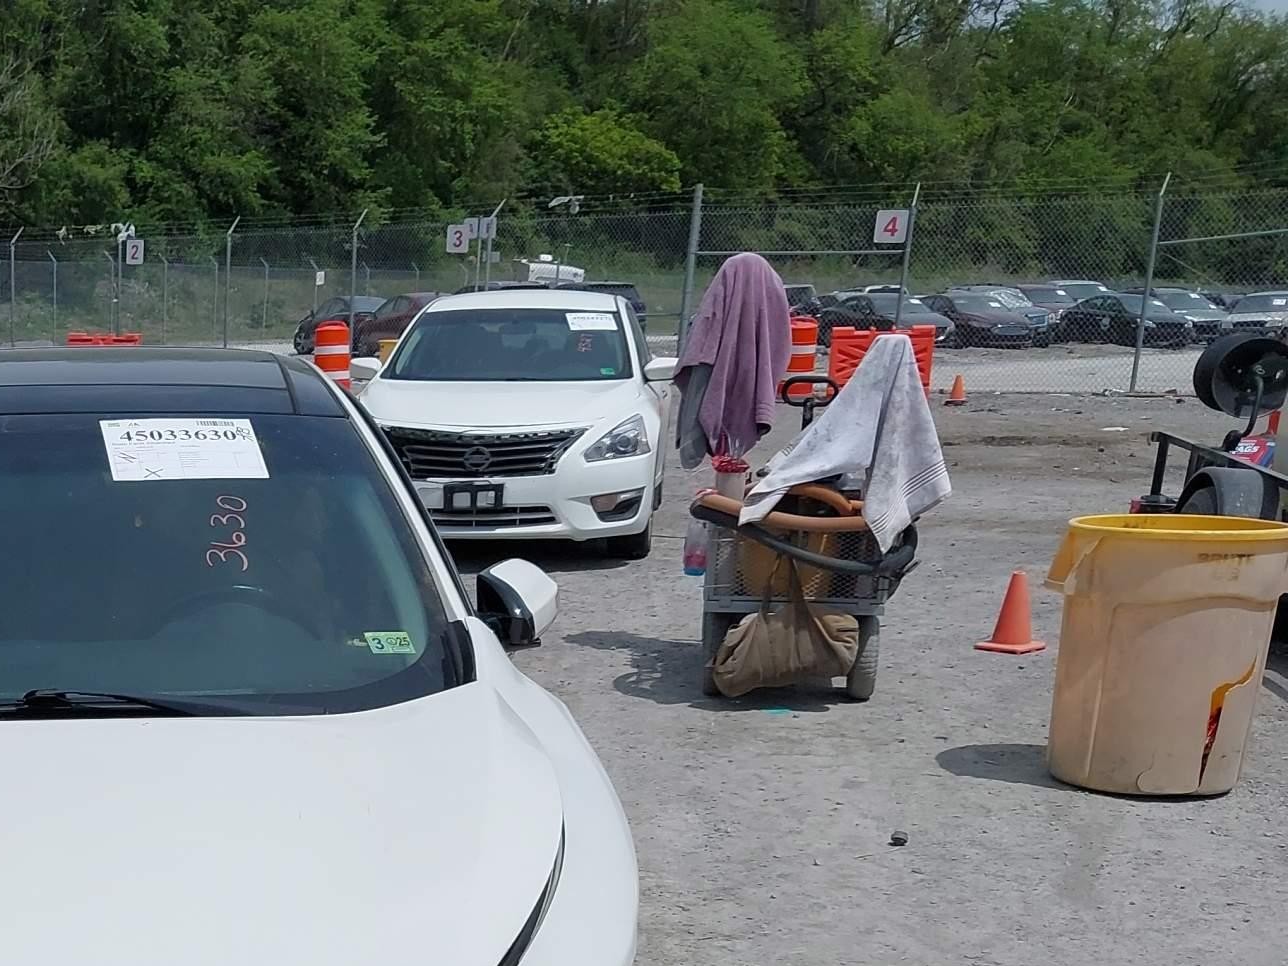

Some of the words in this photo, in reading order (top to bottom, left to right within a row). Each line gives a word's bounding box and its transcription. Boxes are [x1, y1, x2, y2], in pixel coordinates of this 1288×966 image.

[883, 216, 899, 237] 4
[453, 230, 463, 248] 3
[131, 245, 138, 260] 2
[120, 429, 237, 441] 45033630
[206, 495, 248, 571] 3630
[372, 638, 385, 650] 3
